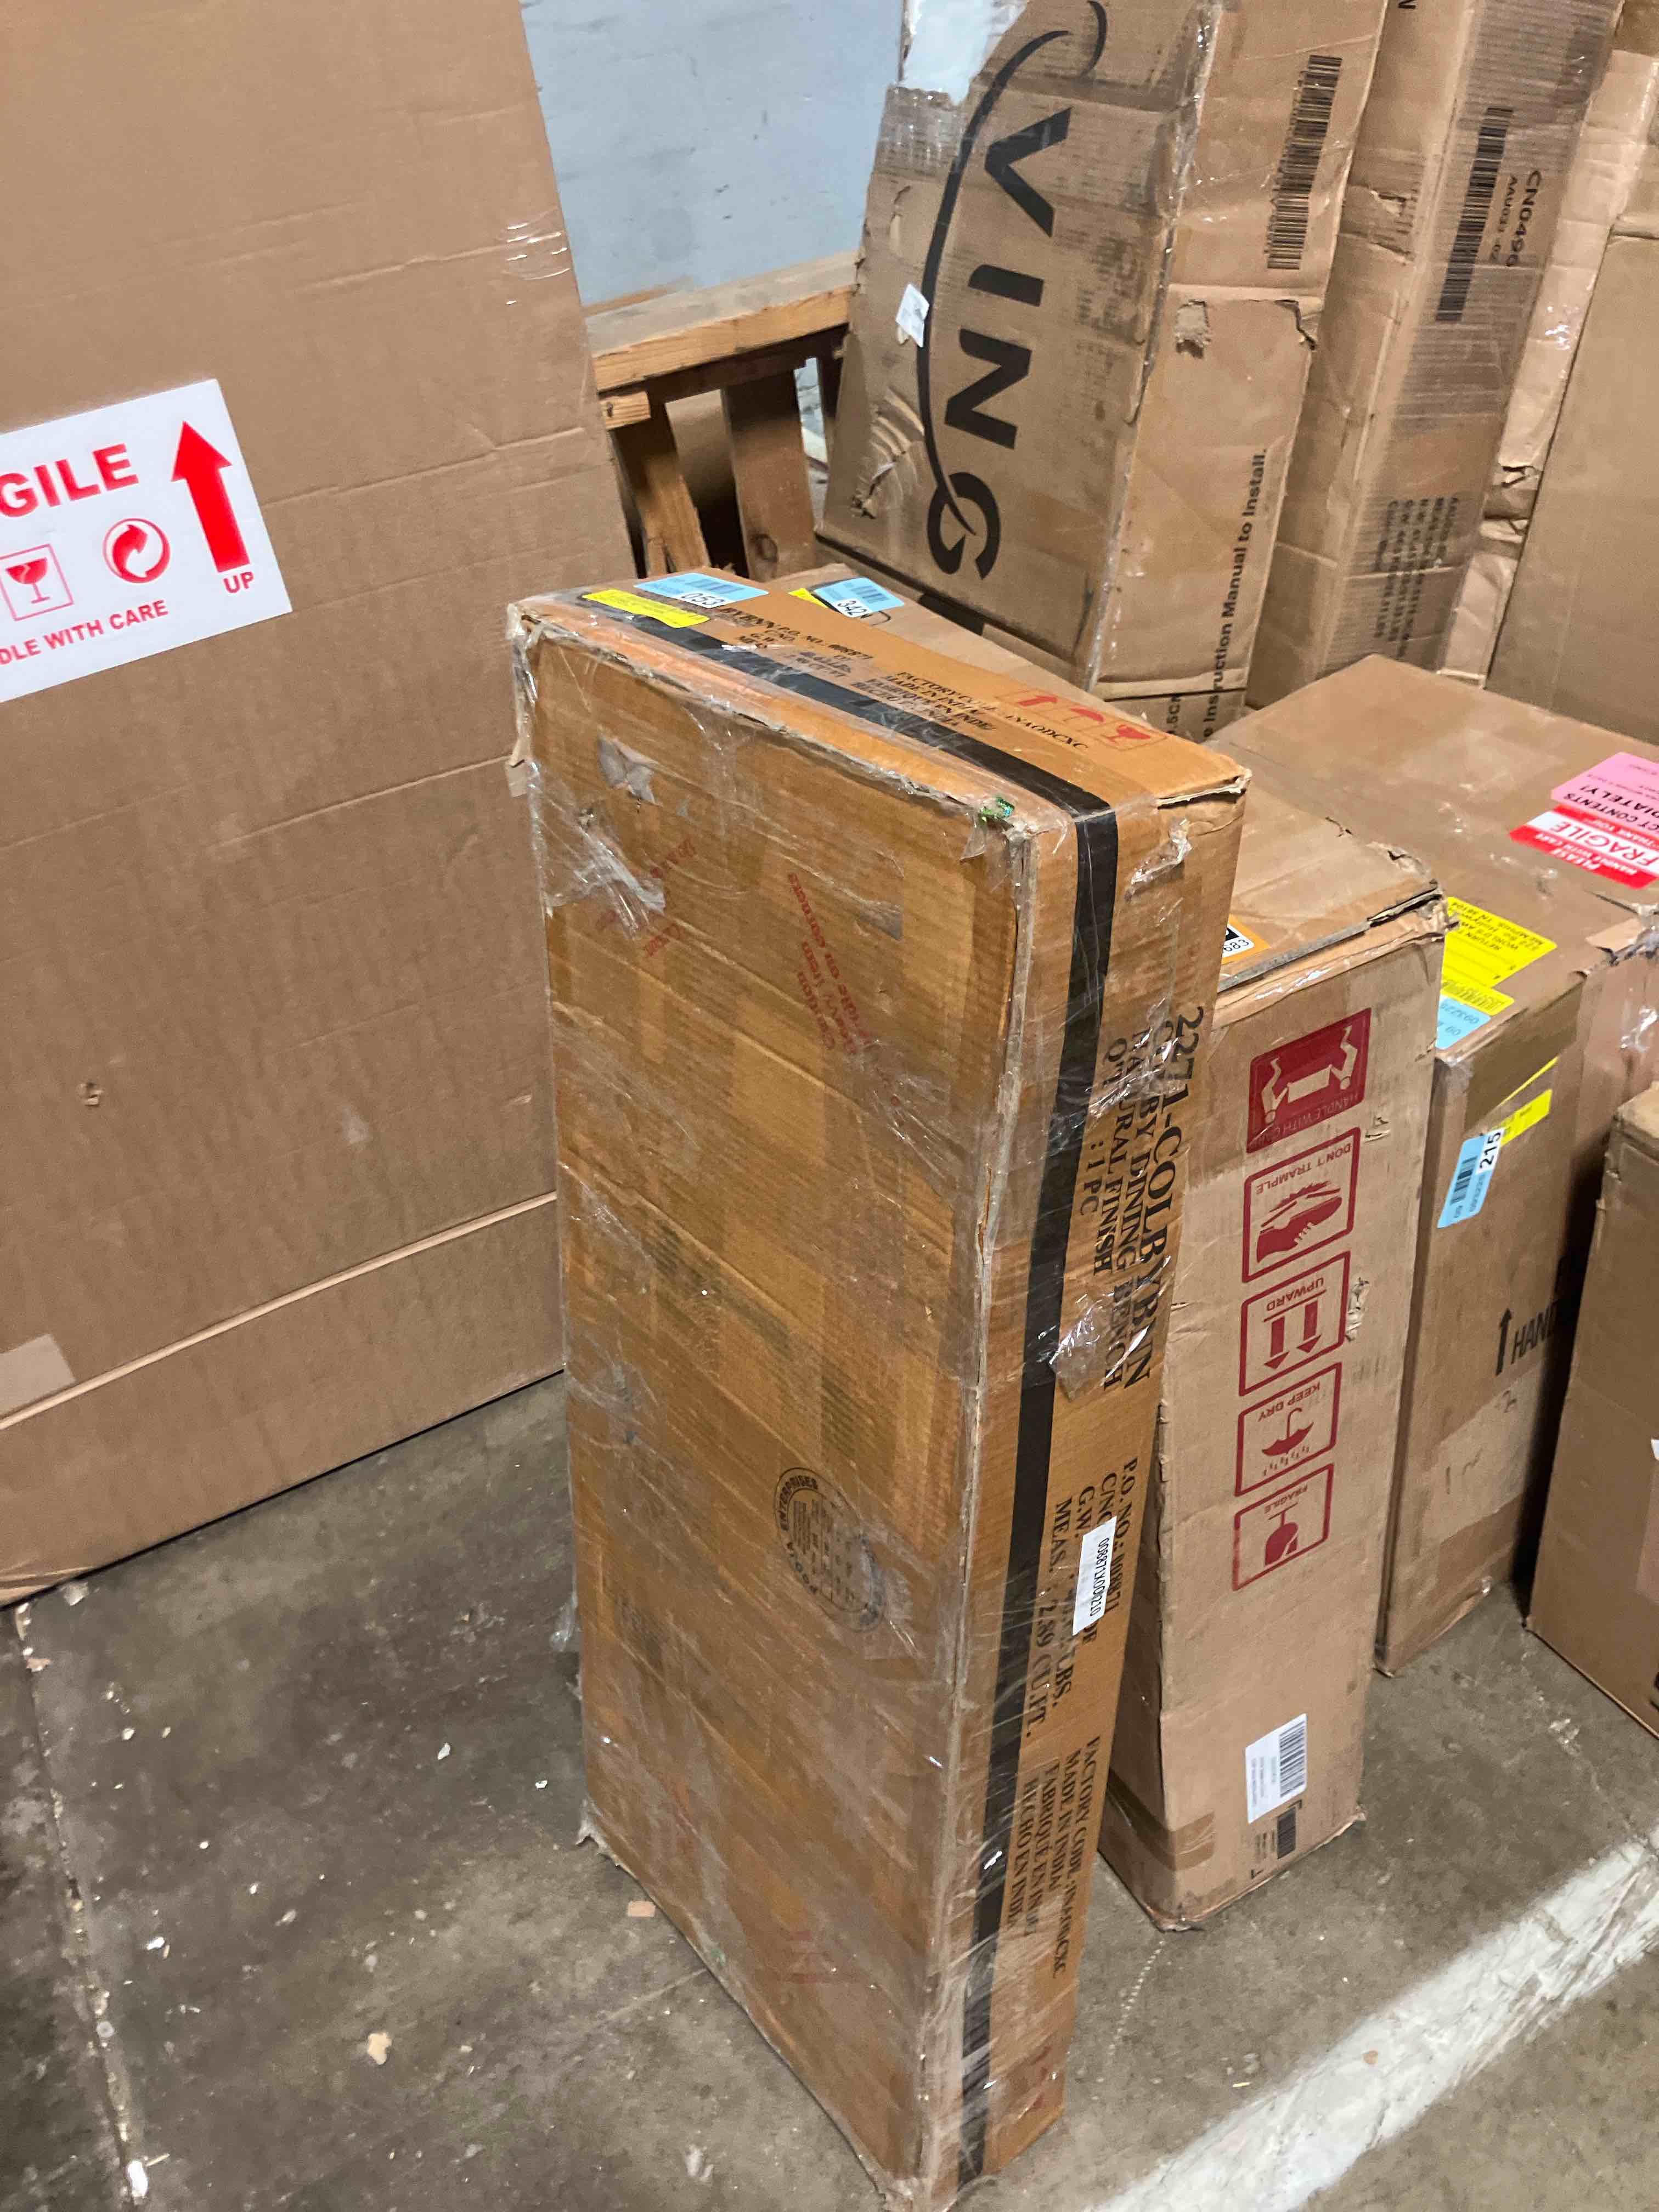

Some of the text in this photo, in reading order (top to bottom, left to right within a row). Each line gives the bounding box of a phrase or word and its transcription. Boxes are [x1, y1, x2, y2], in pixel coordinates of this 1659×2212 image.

[1242, 448, 1266, 520] Install.
[1238, 522, 1253, 544] to
[223, 571, 255, 594] UP
[681, 592, 726, 606] 053
[1222, 548, 1246, 618] Manual
[44, 619, 104, 650] WITH
[109, 600, 168, 629] CARE
[838, 601, 867, 616] 342
[897, 672, 956, 696] FACTORY
[1203, 622, 1233, 723] Insruction
[1562, 793, 1638, 825] CONTENTS
[1549, 821, 1659, 867] FRAGILE
[1093, 1026, 1151, 1277] NAURAL FINISH
[1480, 1132, 1501, 1169] 215
[1080, 1176, 1103, 1216] PC
[1256, 1163, 1312, 1194] TRAMPLE
[1116, 1148, 1152, 1271] DINING
[1267, 1277, 1324, 1311] UPWARD
[1258, 1382, 1321, 1423] KEEP DRY
[1263, 1483, 1308, 1514] FRAGILE
[1060, 1748, 1080, 1810] MADE
[1075, 1736, 1101, 1825] FACTORY
[1012, 1848, 1030, 1877] EN
[1031, 1862, 1048, 1889] EN
[1048, 1833, 1069, 1891] INDIA
